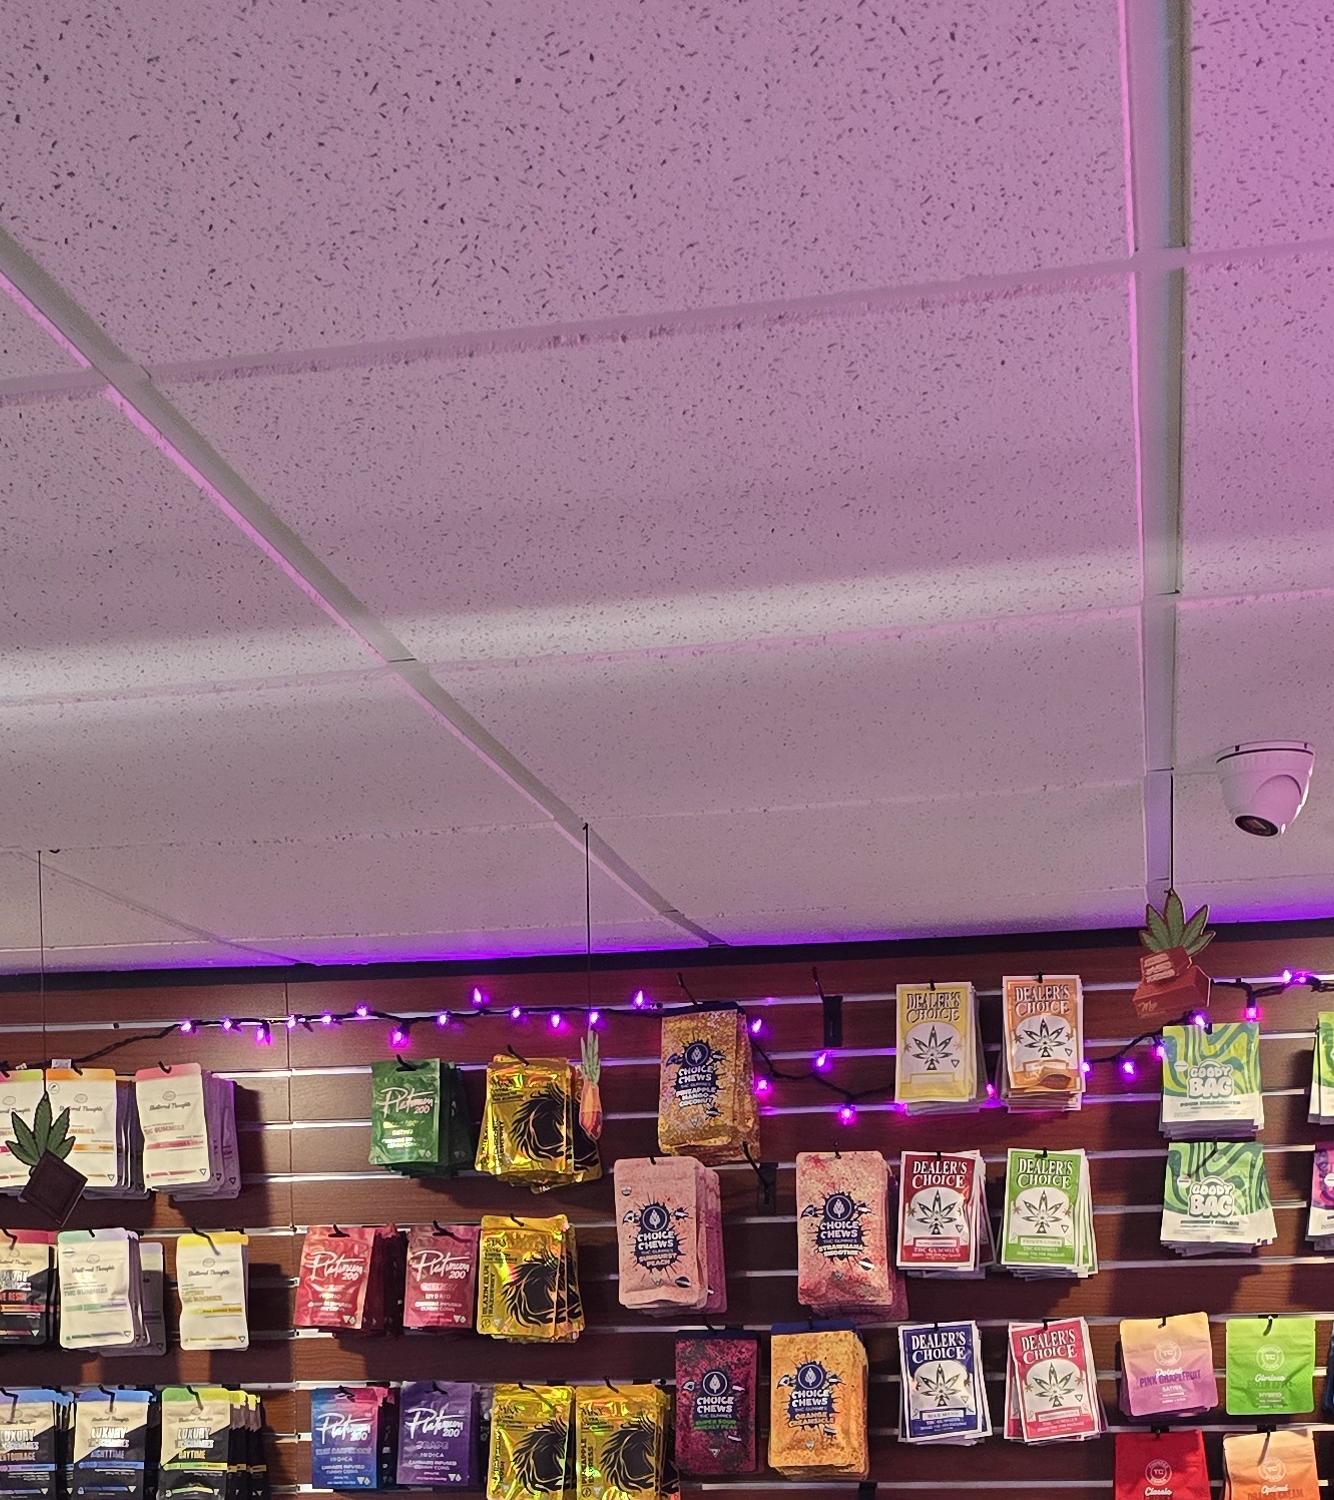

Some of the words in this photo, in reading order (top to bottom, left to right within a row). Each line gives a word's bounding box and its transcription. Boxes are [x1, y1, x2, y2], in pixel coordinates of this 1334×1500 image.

[1014, 984, 1070, 1002] DEALER'S
[1016, 1000, 1070, 1016] CHOICE
[1190, 1065, 1231, 1078] GOODY
[678, 1075, 712, 1084] CHEWS
[1189, 1078, 1233, 1097] BAG
[376, 1087, 434, 1117] Platinum
[414, 1105, 430, 1114] 200
[912, 1161, 967, 1175] DEALER'S
[912, 1175, 965, 1188] CHOICE
[1189, 1194, 1234, 1217] BAG
[821, 1230, 858, 1238] CHEWS
[638, 1240, 674, 1250] CHEWS
